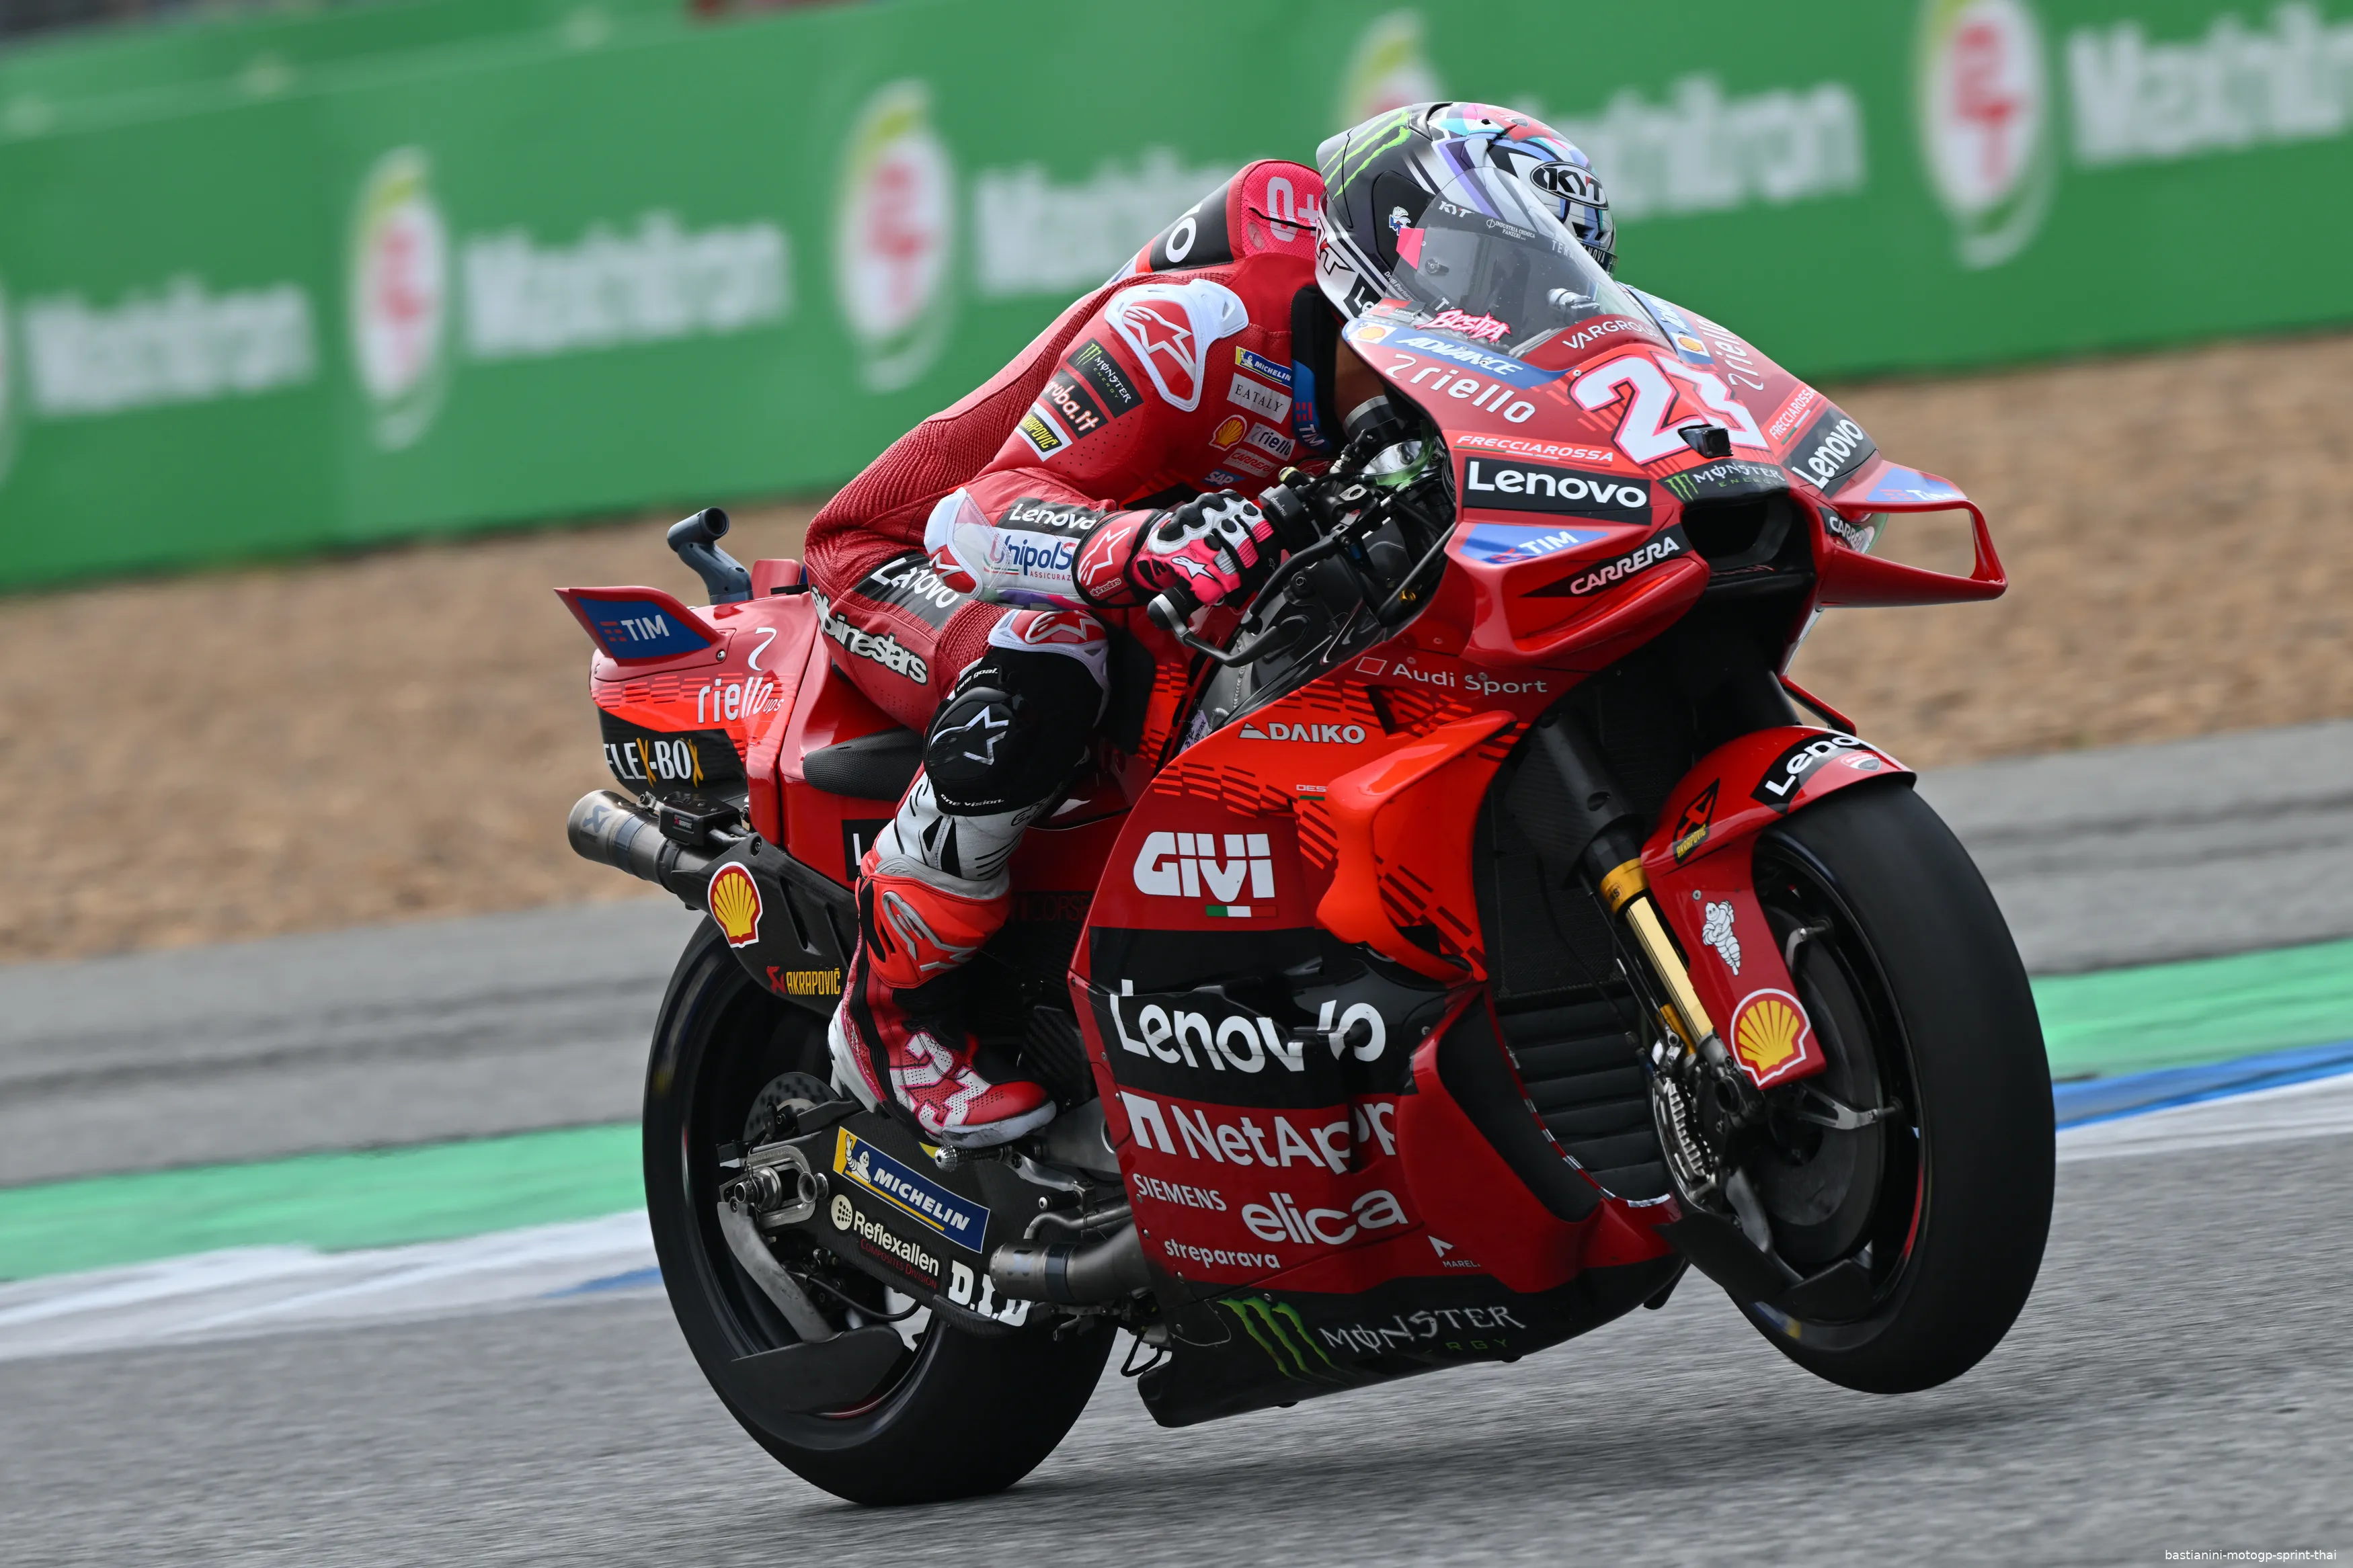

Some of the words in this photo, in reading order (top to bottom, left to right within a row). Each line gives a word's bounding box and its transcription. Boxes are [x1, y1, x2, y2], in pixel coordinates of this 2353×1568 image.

[1548, 167, 1603, 202] KYT
[1439, 200, 1475, 218] KYT
[1495, 220, 1518, 232] INDUSTRIA
[1518, 229, 1536, 239] CHIMICA
[1502, 229, 1521, 239] PANZERI
[1254, 361, 1291, 382] MICHELIN
[1396, 337, 1524, 376] ADVANCE
[1093, 367, 1119, 399] ENERGY
[1094, 356, 1131, 403] MONSTER
[1410, 366, 1536, 423] riello
[1235, 384, 1284, 413] EATALY
[1570, 354, 1772, 465] 23
[1769, 386, 1817, 440] FRECCIAROSSA
[1259, 431, 1292, 456] riello
[1456, 435, 1614, 463] FRECCIAROSSA
[1791, 418, 1864, 490] Lenovo
[1205, 471, 1234, 485] SAP
[1468, 461, 1648, 508] Lenovo
[1519, 530, 1580, 554] TIM
[1030, 571, 1072, 581] ASSICURAZ
[1570, 536, 1681, 595] CARRERA
[621, 615, 670, 641] TIM
[1392, 663, 1455, 688] Audi
[1464, 674, 1548, 696] Sport
[698, 677, 774, 724] riello
[1268, 722, 1366, 744] DAIKO
[1133, 831, 1276, 903] GIVI
[1109, 979, 1386, 1074] Lenovo
[873, 1167, 971, 1231] MICHELIN
[1133, 1172, 1228, 1212] SIEMENS
[1241, 1189, 1409, 1245] elica
[853, 1210, 940, 1276] Reflexallen
[1164, 1238, 1281, 1269] streparava
[1318, 1305, 1527, 1355] MONSTER
